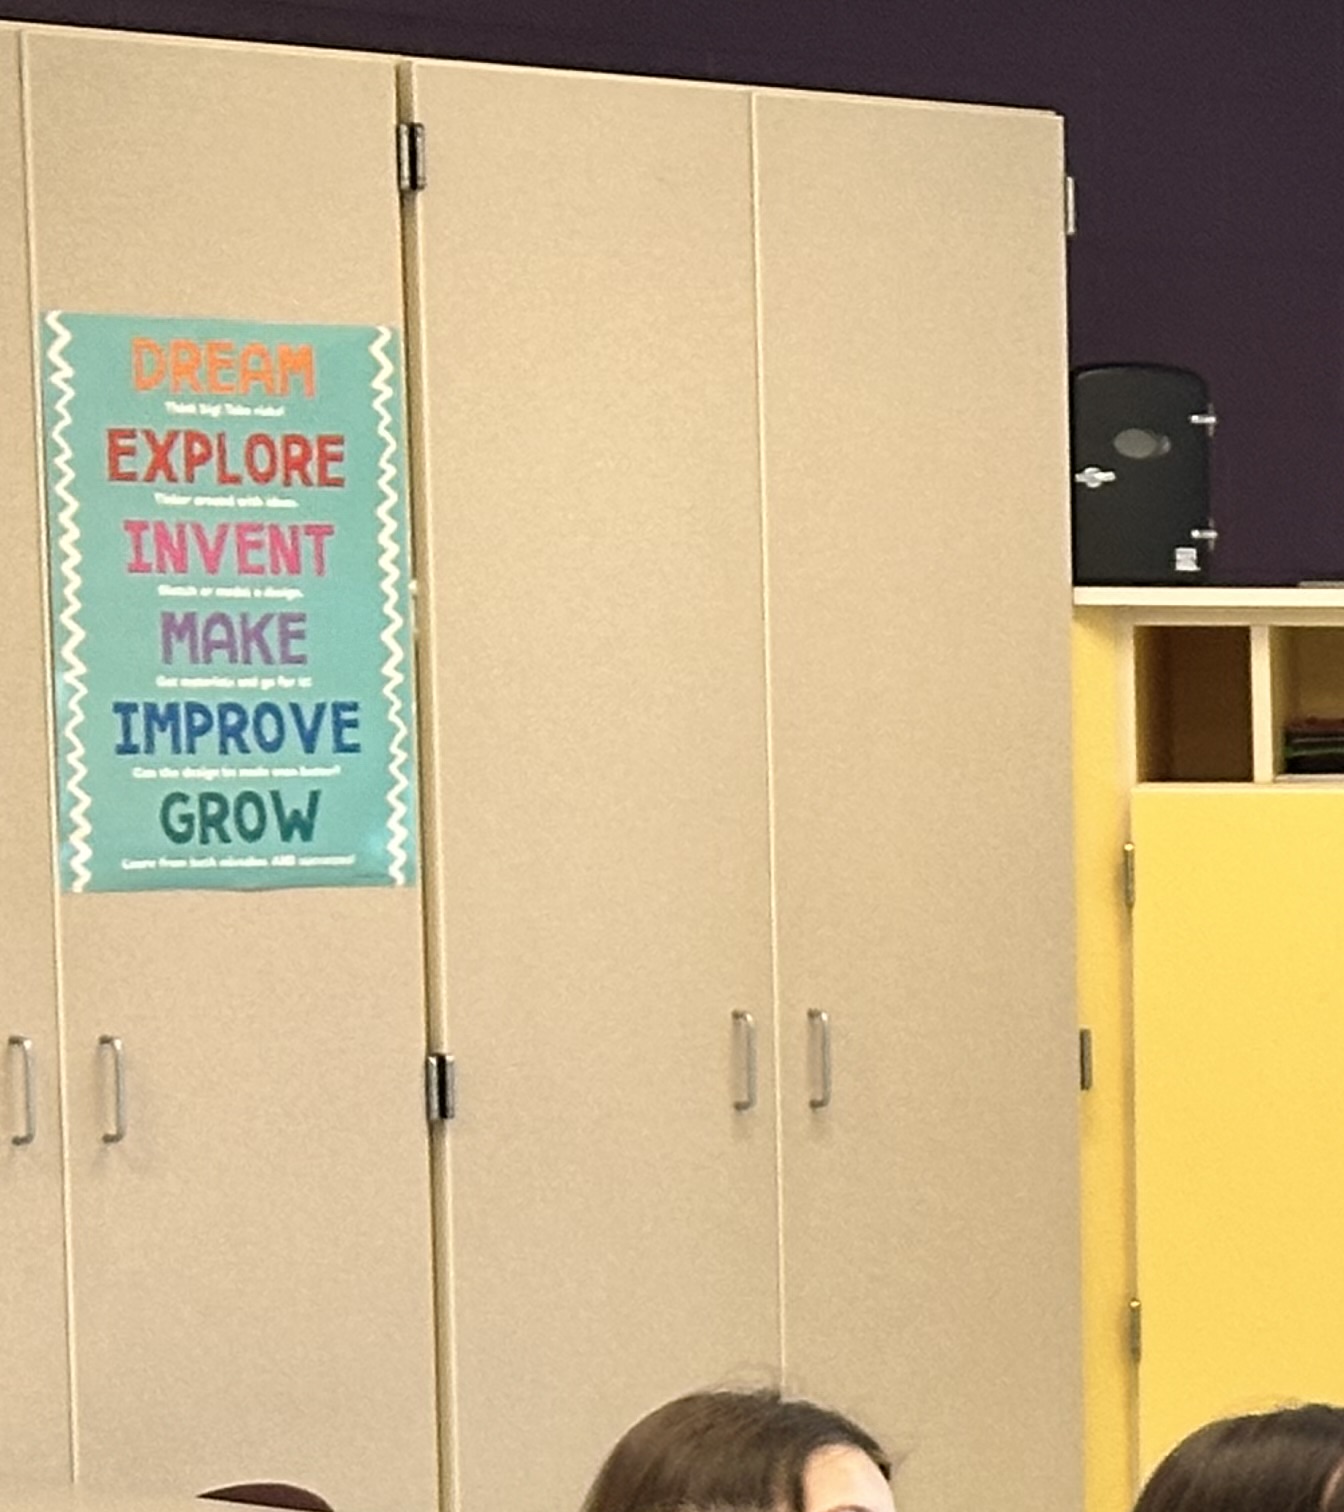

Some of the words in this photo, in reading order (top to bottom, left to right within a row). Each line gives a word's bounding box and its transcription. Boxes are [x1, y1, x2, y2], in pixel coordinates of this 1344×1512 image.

[130, 336, 316, 398] DREAM
[106, 427, 346, 488] EXPLORE
[123, 519, 336, 578] INVENT
[159, 611, 309, 666] MAKE
[111, 700, 362, 756] IMPROVE
[159, 789, 322, 846] GROW
